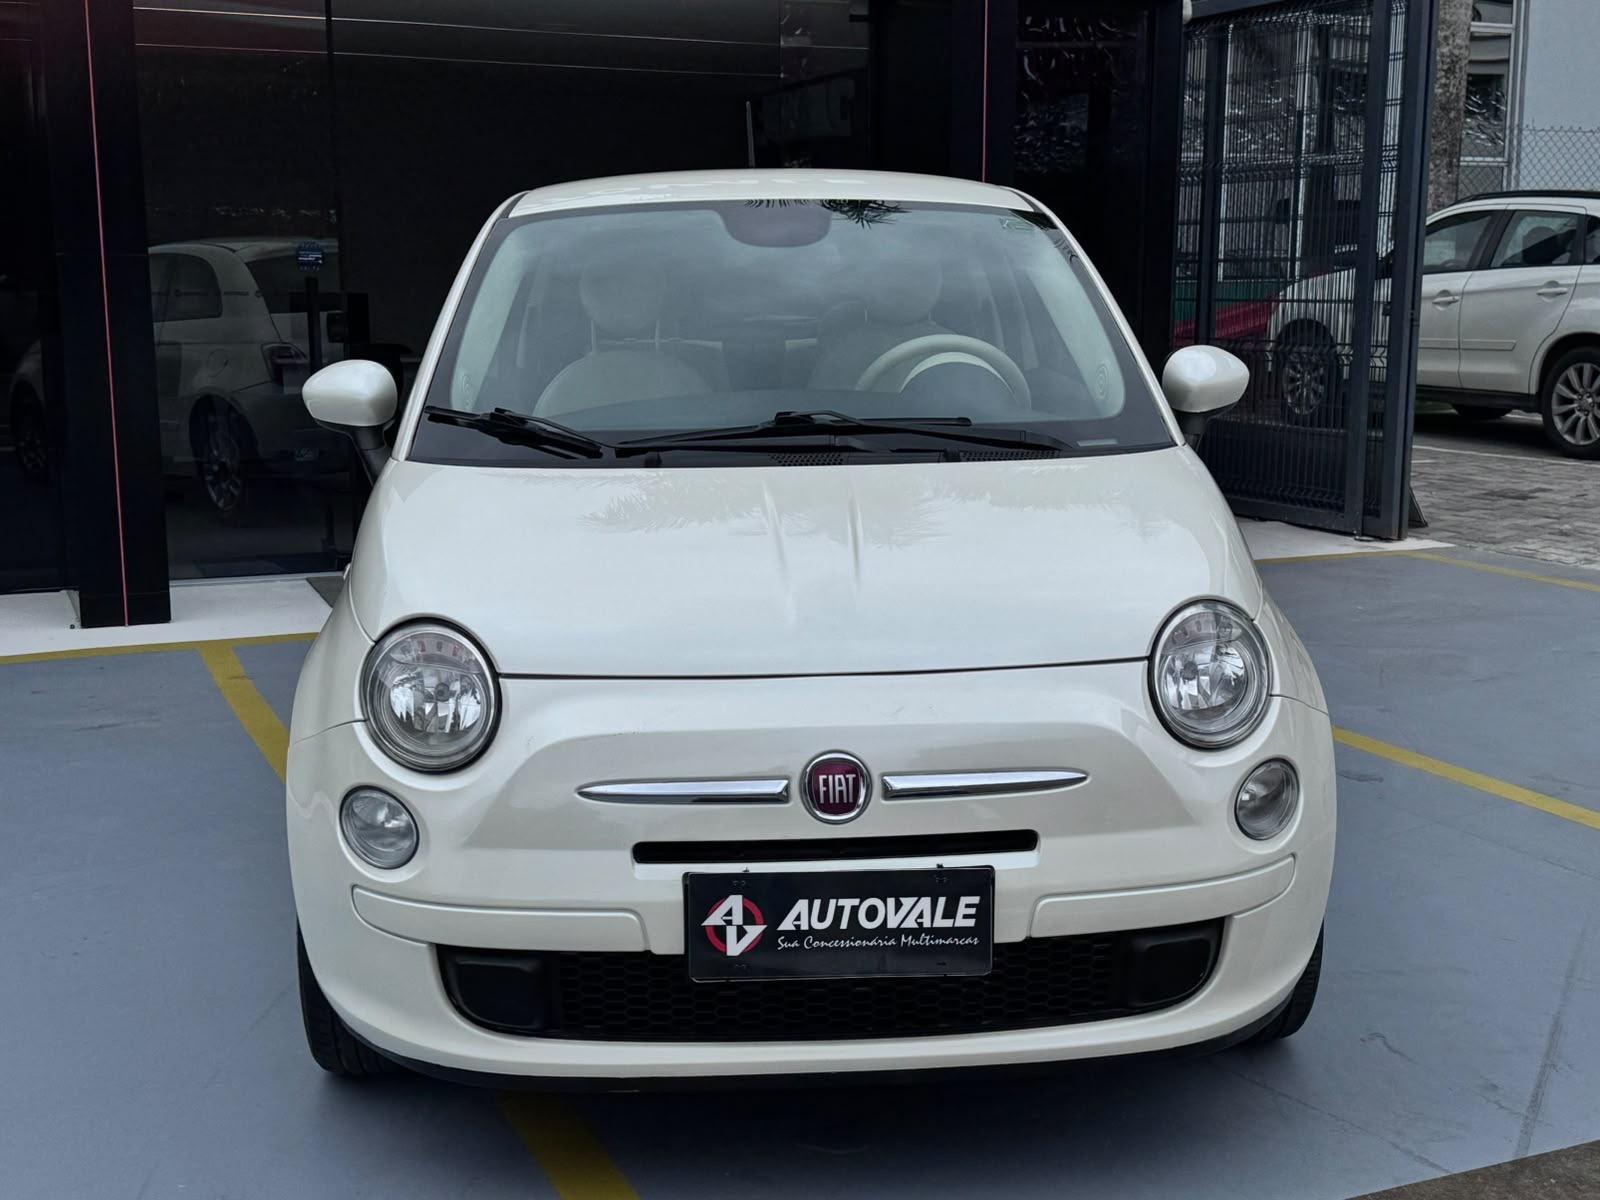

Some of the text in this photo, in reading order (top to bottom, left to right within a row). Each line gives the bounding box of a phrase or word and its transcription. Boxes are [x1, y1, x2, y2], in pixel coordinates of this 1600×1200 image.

[818, 774, 857, 804] FIAT
[777, 896, 980, 931] AUTOVALE
[777, 932, 980, 950] Sua Concessionária Multimarcas
